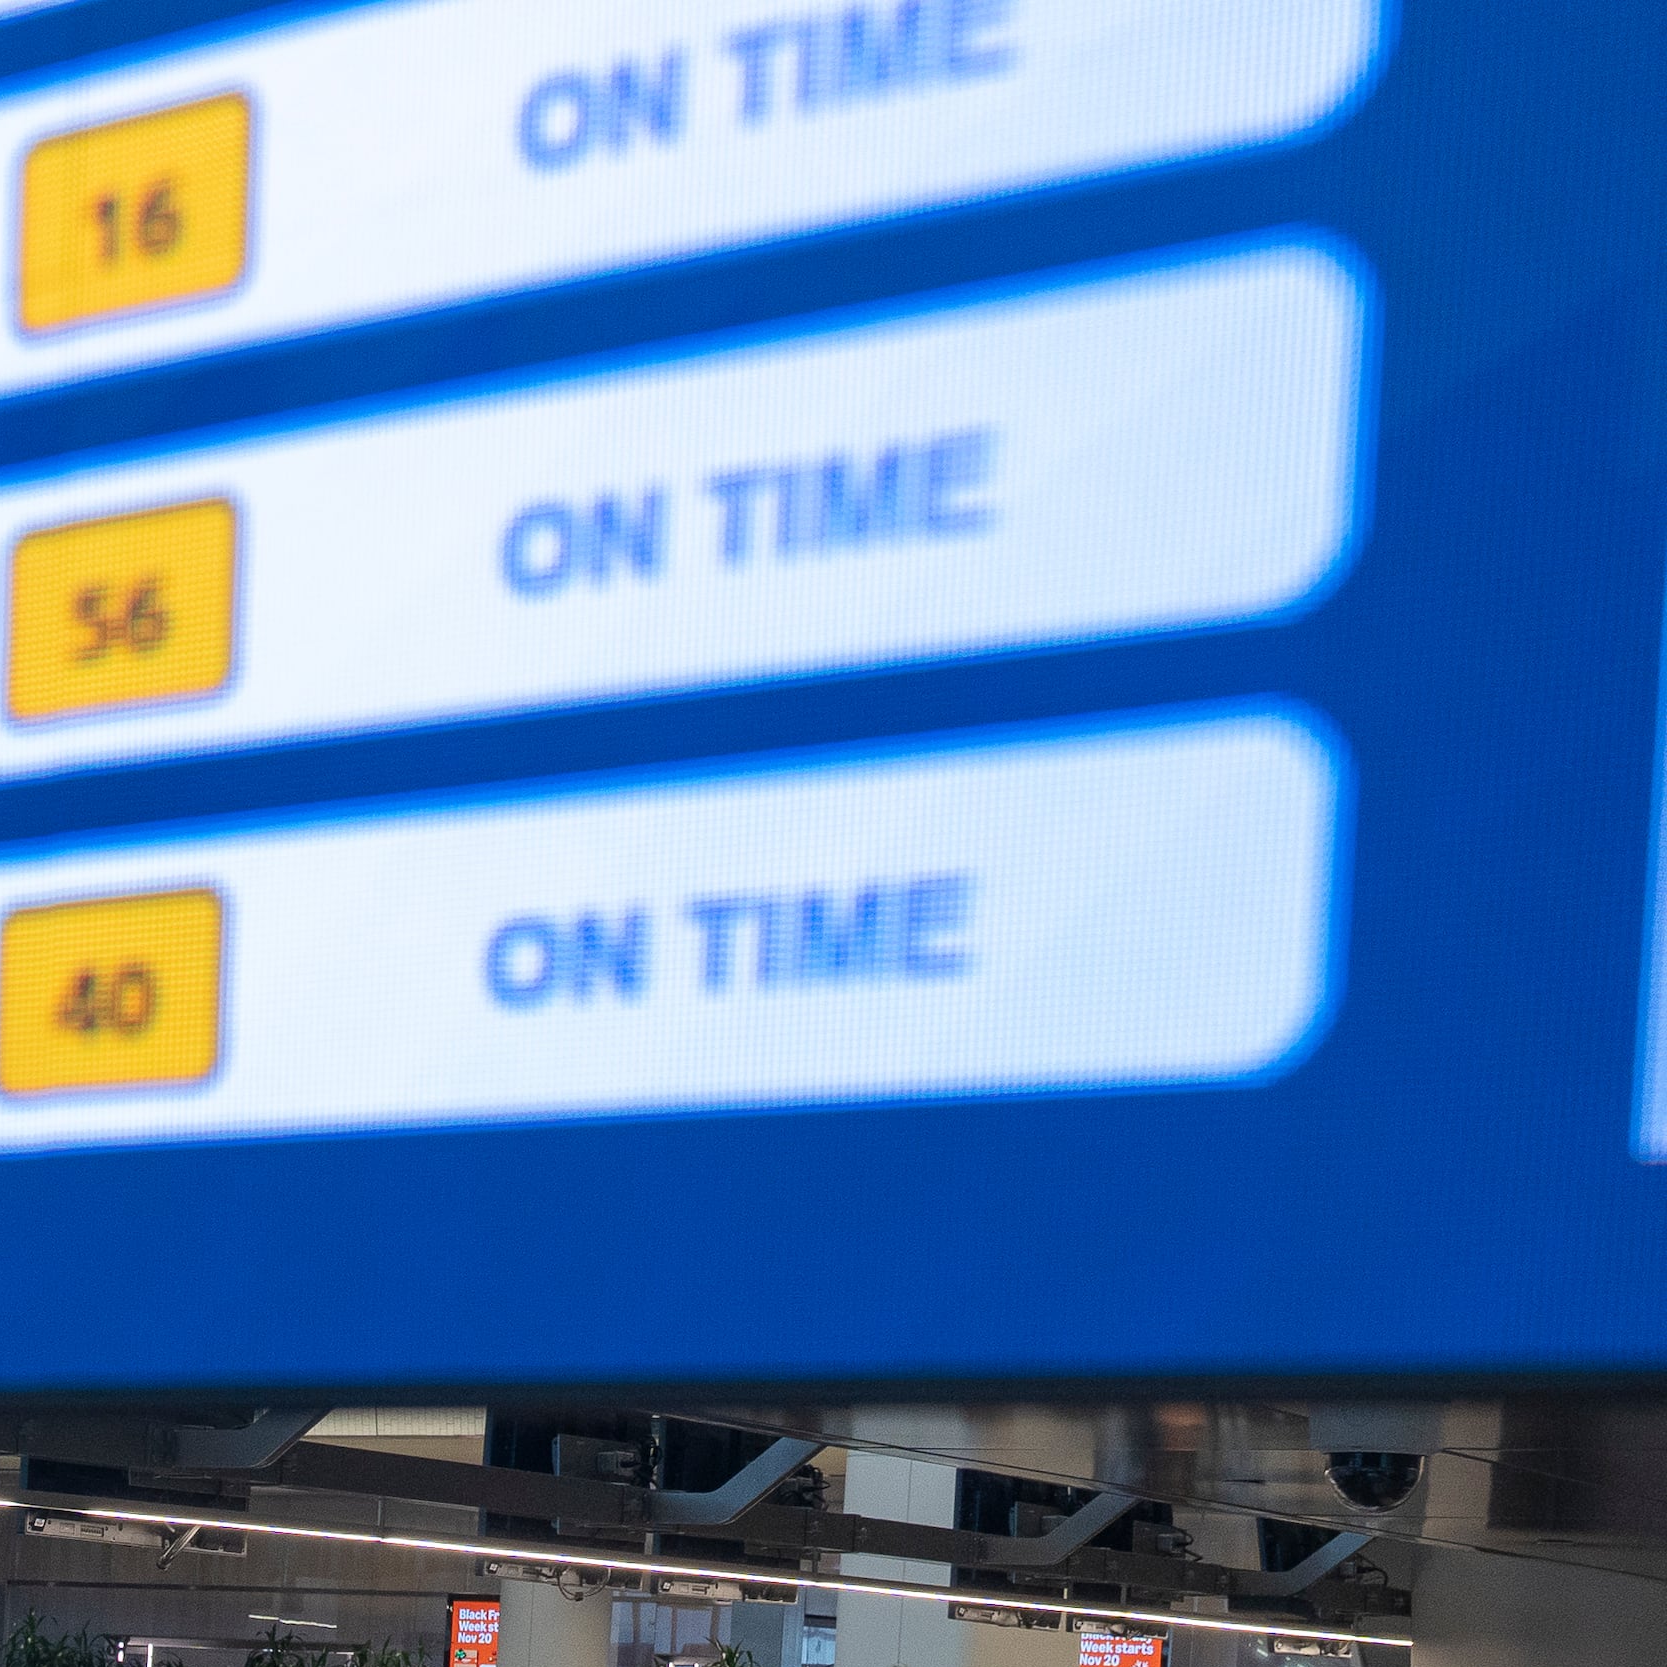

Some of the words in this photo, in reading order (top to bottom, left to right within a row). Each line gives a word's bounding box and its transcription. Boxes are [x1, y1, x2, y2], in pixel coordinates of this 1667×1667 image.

[90, 178, 183, 270] 16
[517, 47, 687, 173] ON
[722, 0, 1025, 127] TIME
[72, 574, 170, 664] 56
[501, 484, 665, 600] ON
[701, 422, 1003, 570] TIME
[54, 959, 156, 1044] 40
[481, 903, 650, 1014] ON
[684, 870, 975, 995] TIME
[459, 1608, 487, 1620] Black
[459, 1621, 487, 1632] Week
[457, 1632, 477, 1643] Nov
[478, 1633, 492, 1644] 20
[1080, 1642, 1113, 1653] Week
[1115, 1643, 1153, 1655] starts
[1079, 1654, 1102, 1666] Nov
[1103, 1655, 1120, 1666] 20
